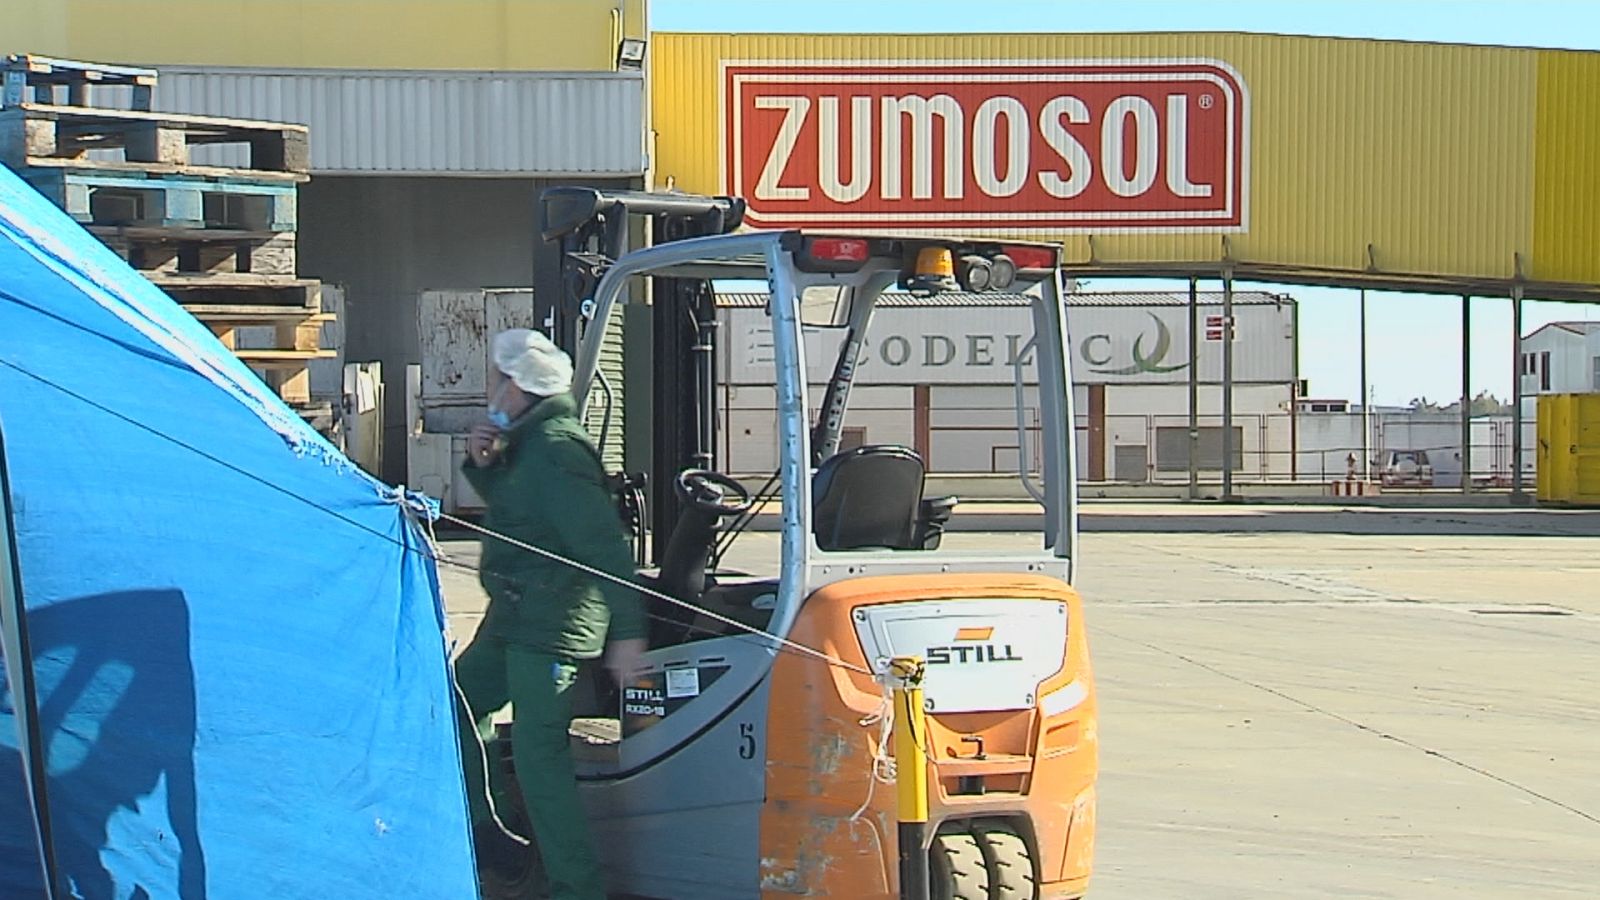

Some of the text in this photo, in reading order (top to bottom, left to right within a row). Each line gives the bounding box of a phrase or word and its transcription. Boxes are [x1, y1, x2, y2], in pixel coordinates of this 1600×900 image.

[754, 94, 1212, 203] ZUMOSOL
[838, 334, 1112, 366] ODELC
[926, 644, 1022, 664] STILL
[625, 688, 665, 701] STILL
[738, 722, 756, 760] 5
